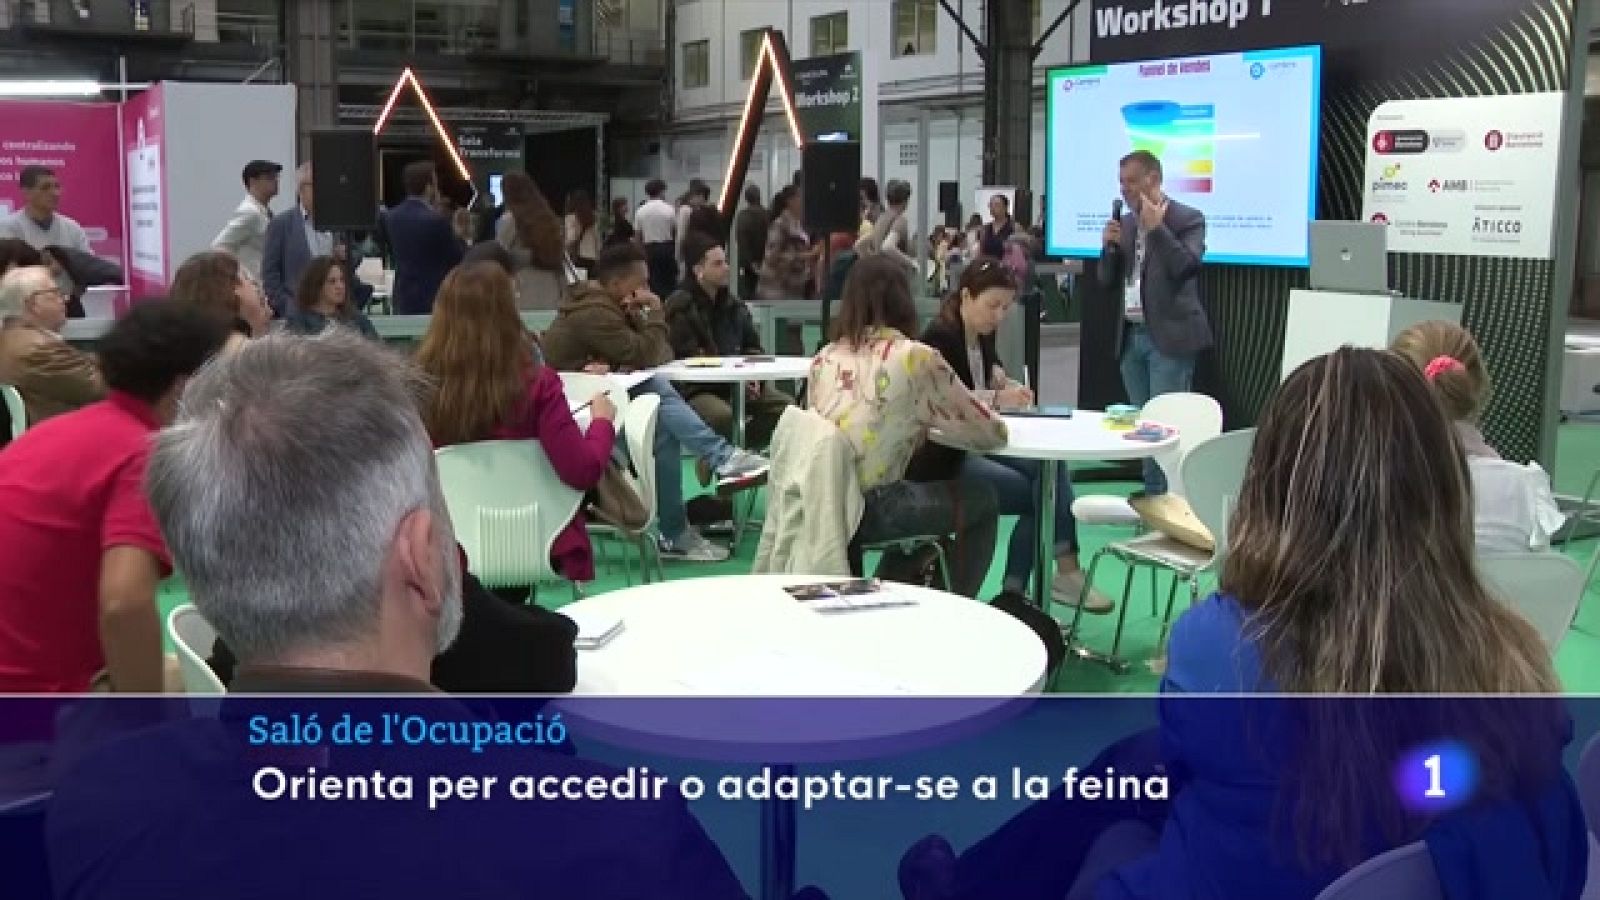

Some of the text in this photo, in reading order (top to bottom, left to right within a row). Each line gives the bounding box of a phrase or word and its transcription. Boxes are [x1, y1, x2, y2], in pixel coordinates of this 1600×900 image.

[1096, 0, 1248, 38] Workshop
[2, 140, 76, 151] centralizando
[1442, 179, 1468, 192] AMB
